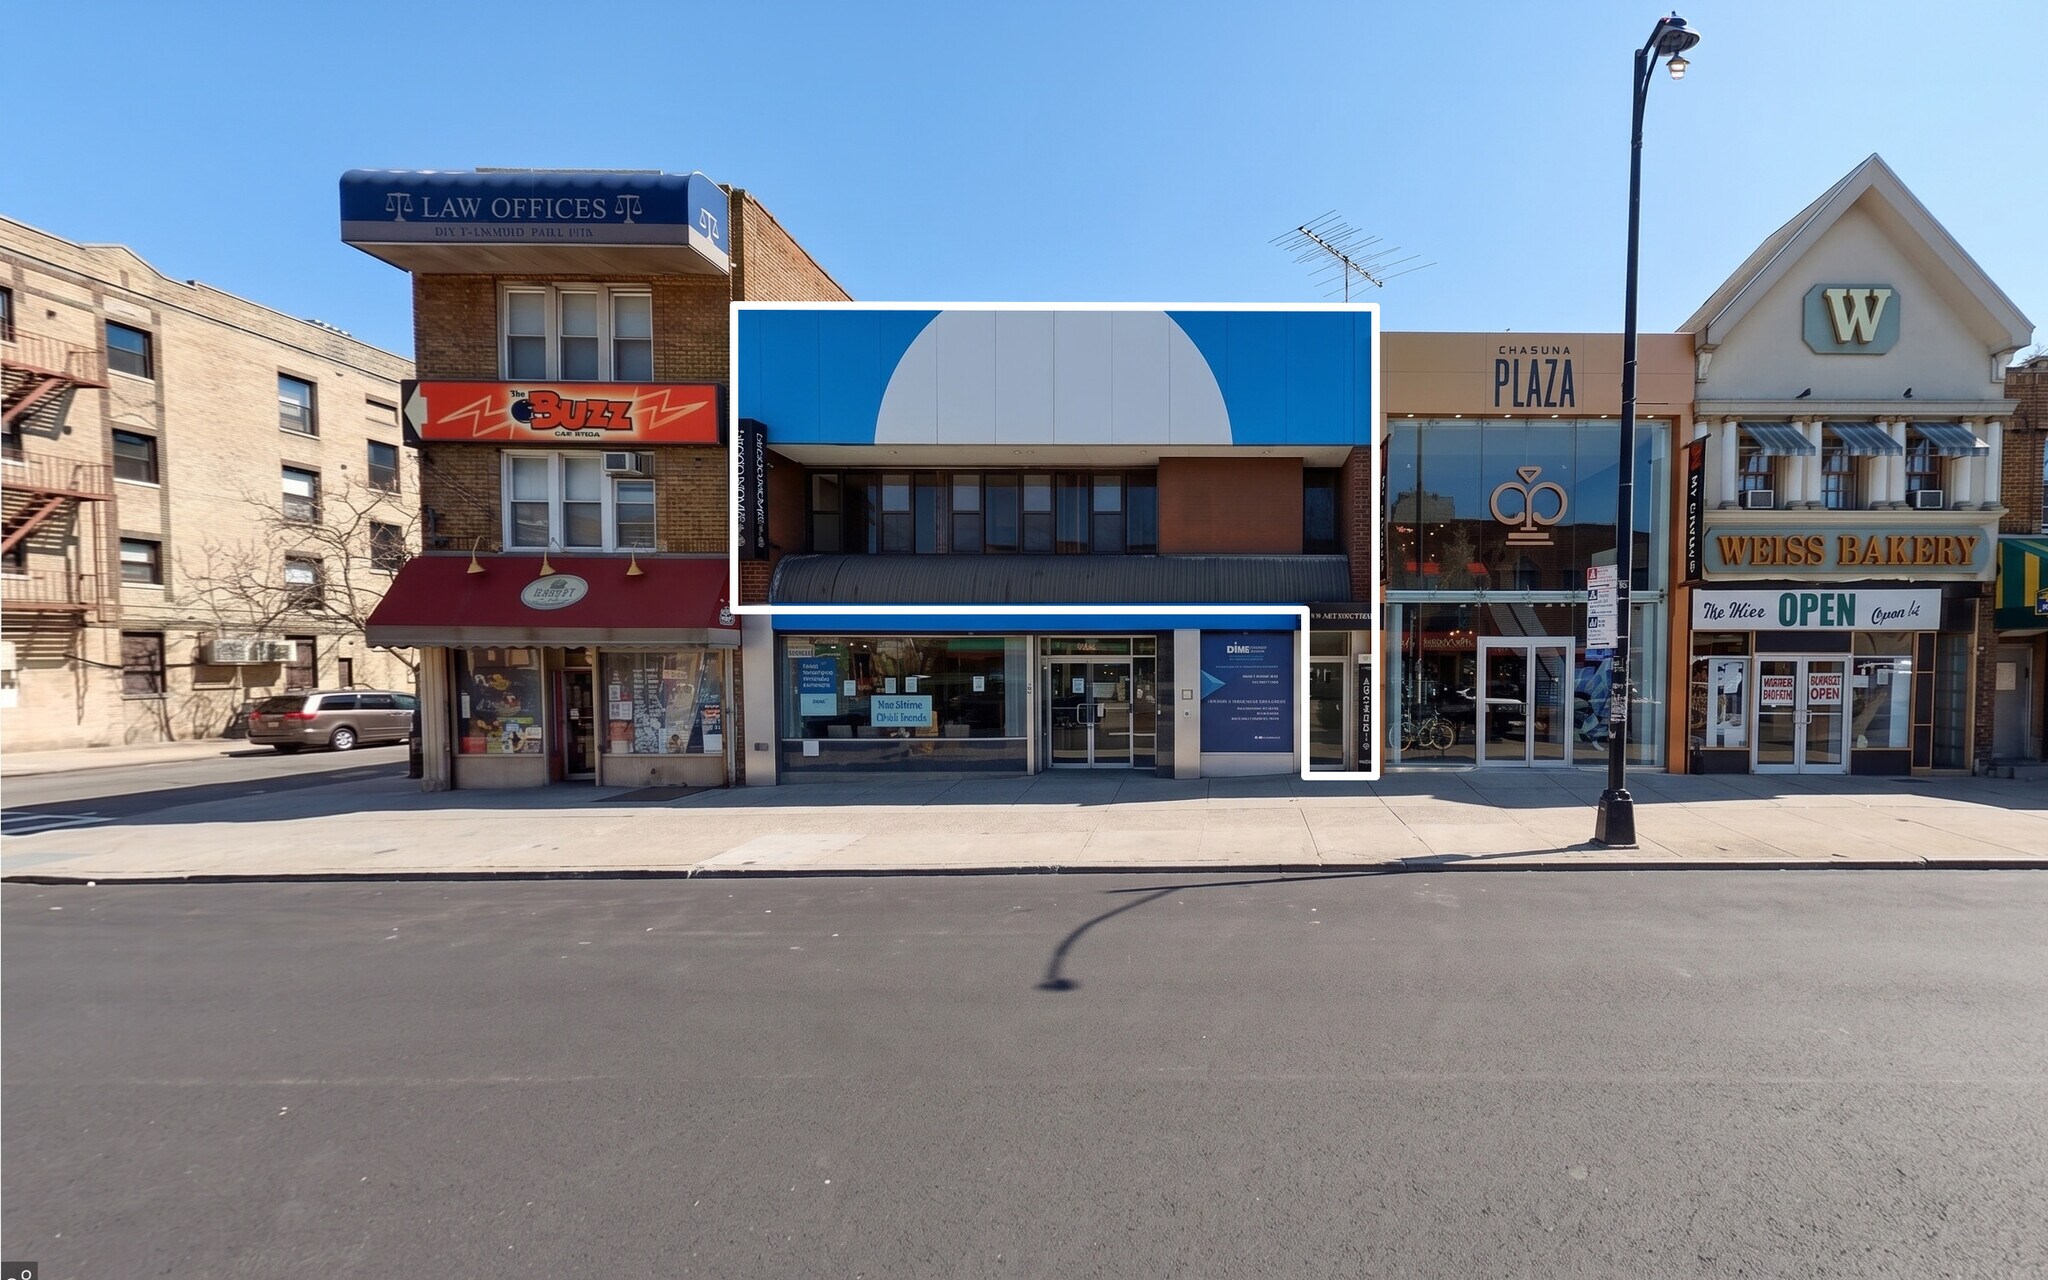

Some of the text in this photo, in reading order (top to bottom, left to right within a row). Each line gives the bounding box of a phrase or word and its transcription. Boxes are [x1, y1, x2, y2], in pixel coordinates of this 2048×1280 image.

[421, 196, 607, 219] LAW OFFICES
[1822, 288, 1892, 344] W
[1498, 345, 1571, 355] CHASUNA
[1494, 358, 1576, 408] PLAZA
[1717, 535, 1825, 566] WEISS
[1837, 535, 1980, 566] BAKERY
[1778, 592, 1856, 627] OPEN
[1810, 688, 1840, 700] OPEN
